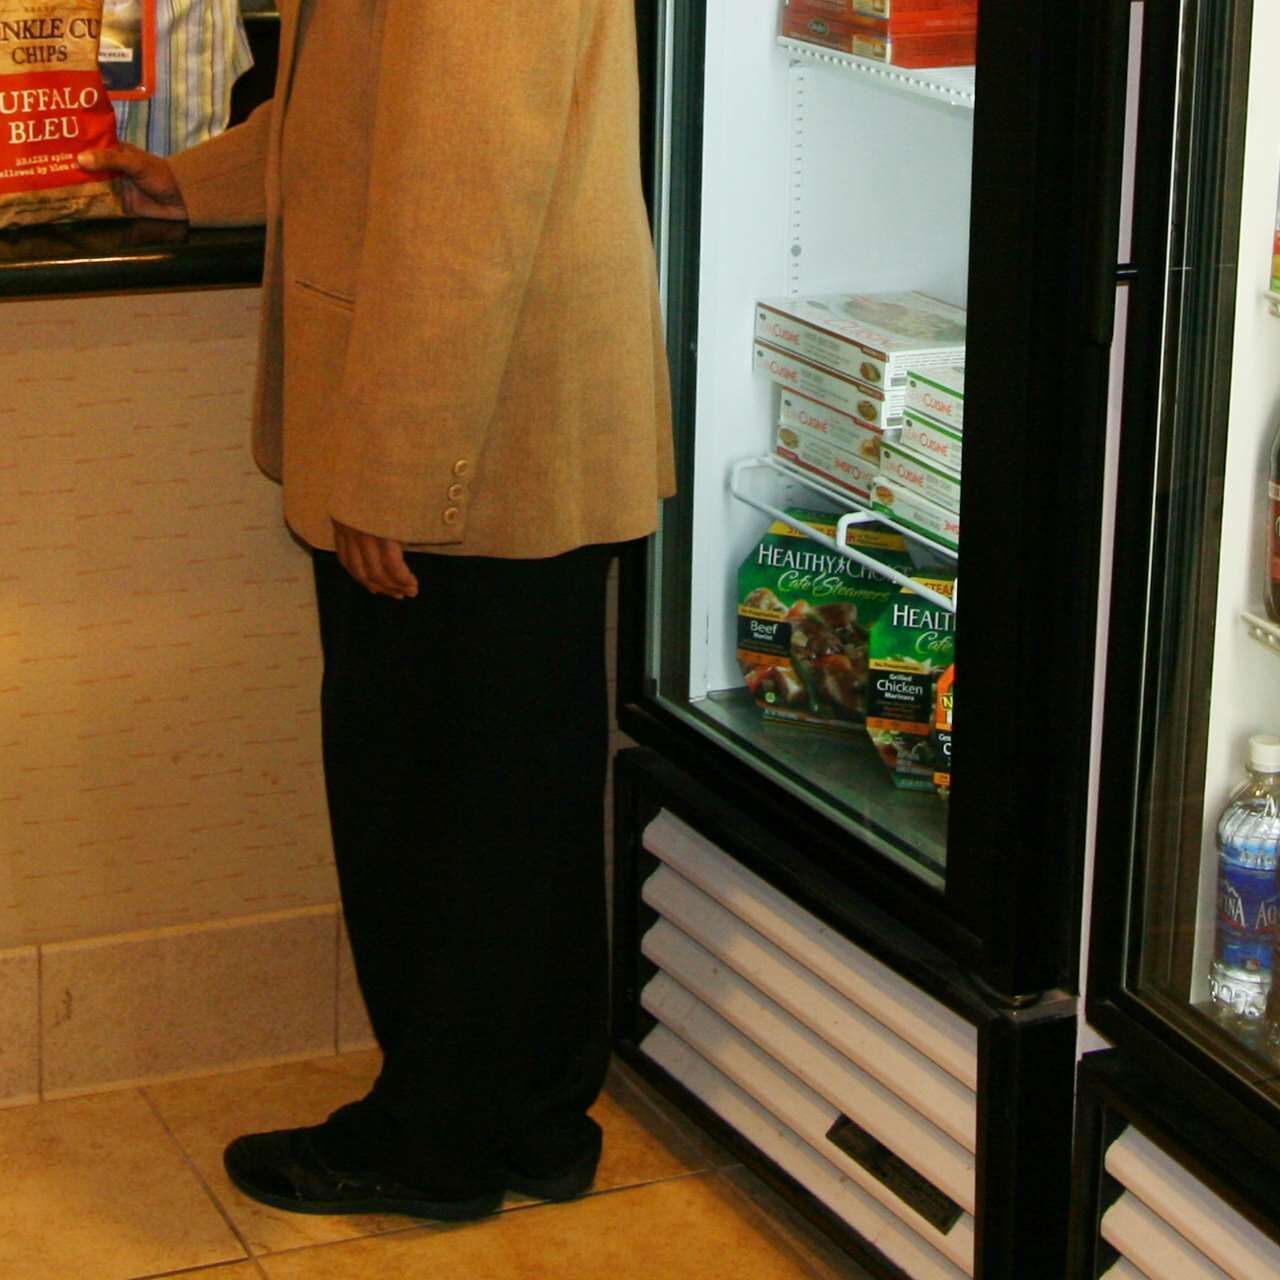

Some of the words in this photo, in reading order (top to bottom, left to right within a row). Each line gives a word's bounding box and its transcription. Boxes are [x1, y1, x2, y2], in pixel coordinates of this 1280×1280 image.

[12, 44, 68, 65] CHIPS
[9, 116, 80, 144] BLEU
[758, 543, 837, 575] HEALTHY
[750, 620, 779, 635] Beef
[893, 604, 956, 632] HEALT
[876, 679, 923, 696] Chicken
